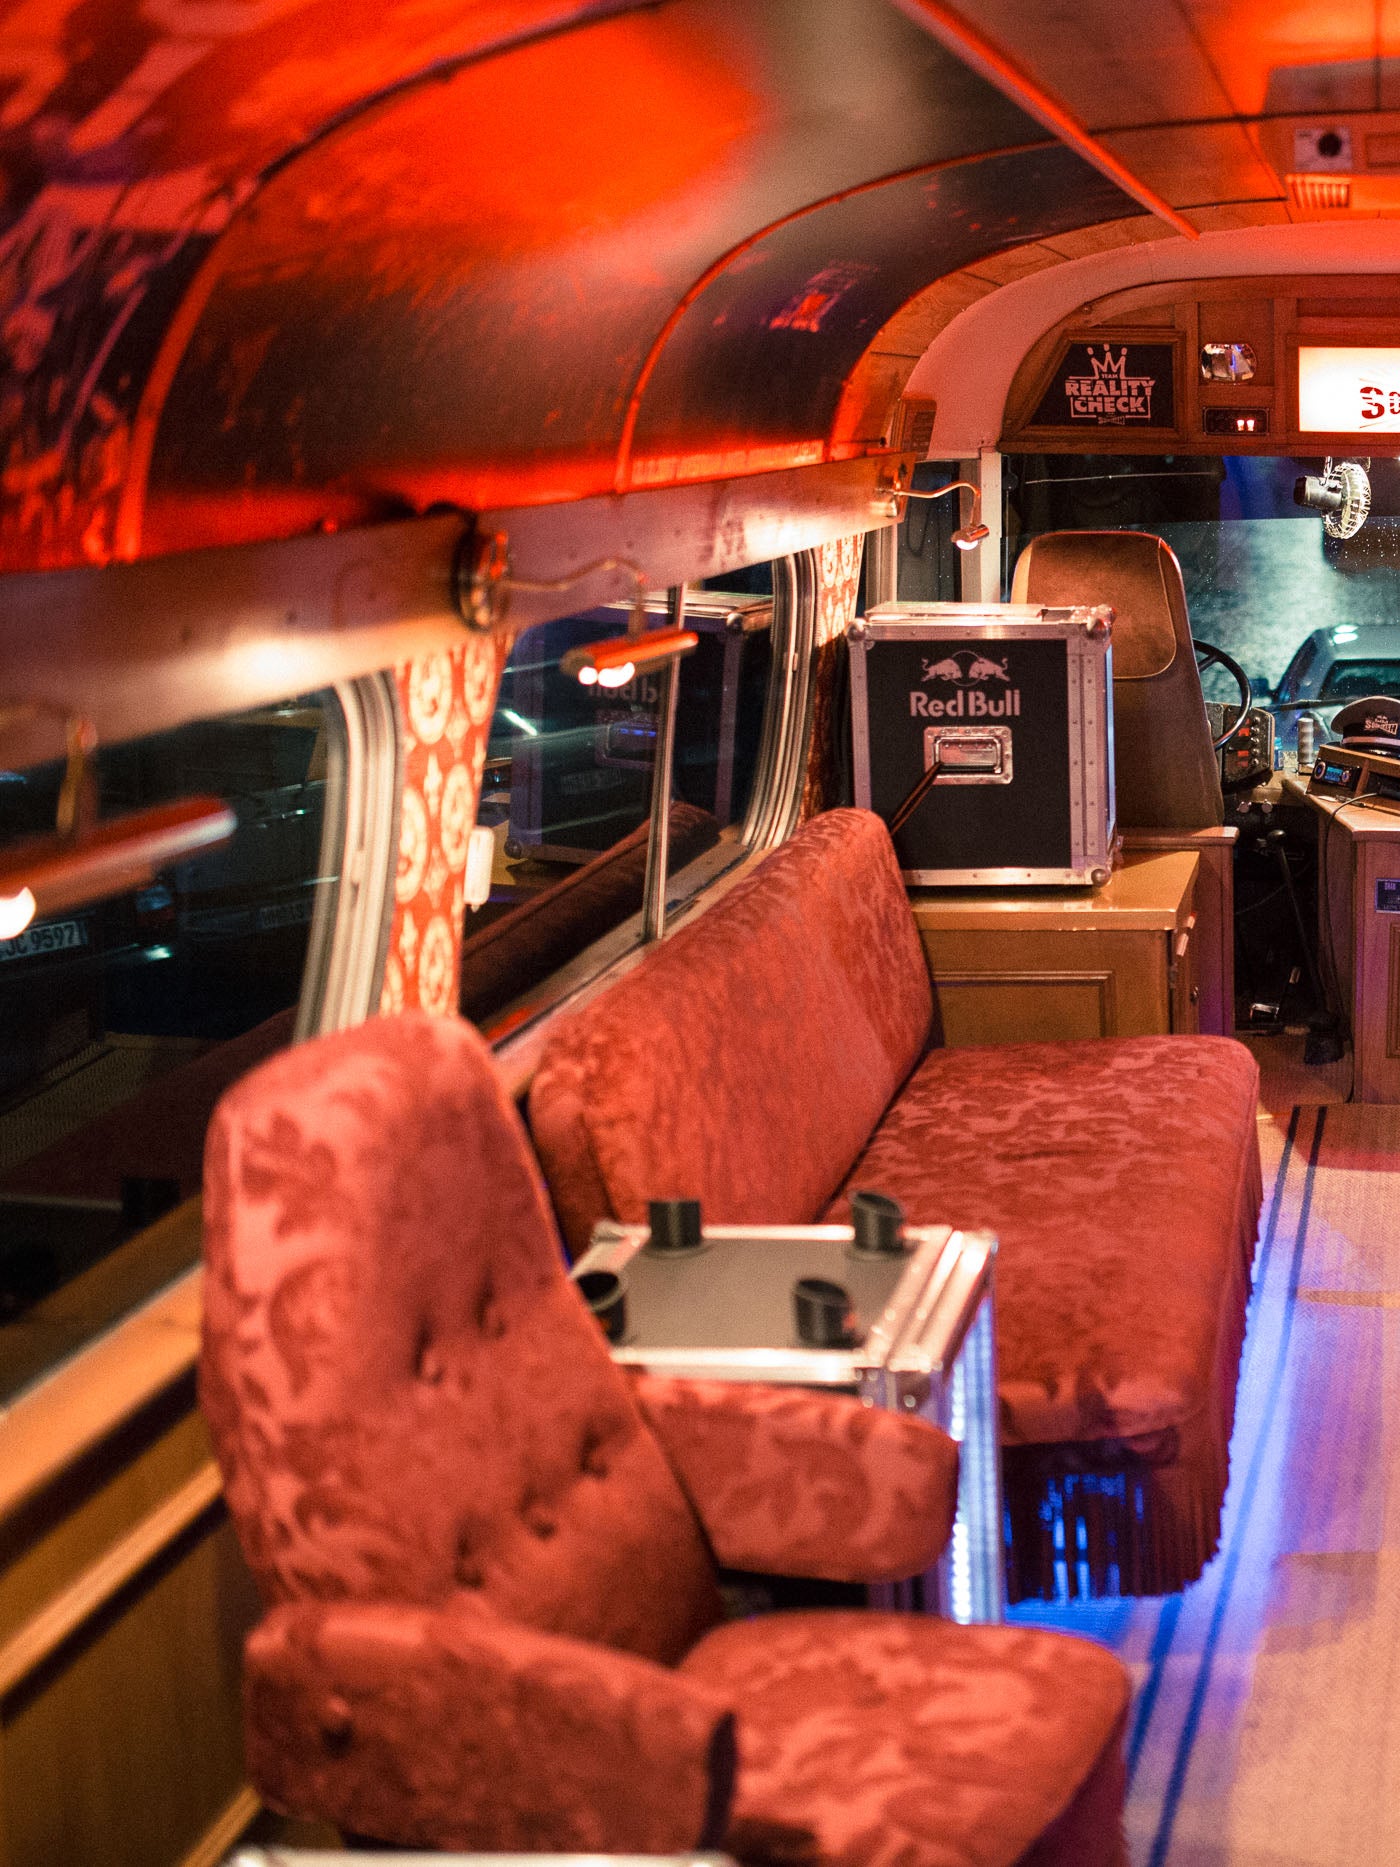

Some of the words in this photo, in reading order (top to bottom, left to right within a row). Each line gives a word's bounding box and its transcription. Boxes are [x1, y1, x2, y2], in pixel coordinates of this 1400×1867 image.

[1065, 379, 1156, 397] REALITY
[1073, 396, 1147, 413] CHECK
[910, 690, 964, 717] Red
[968, 689, 1021, 717] Bull
[31, 925, 75, 951] 9597
